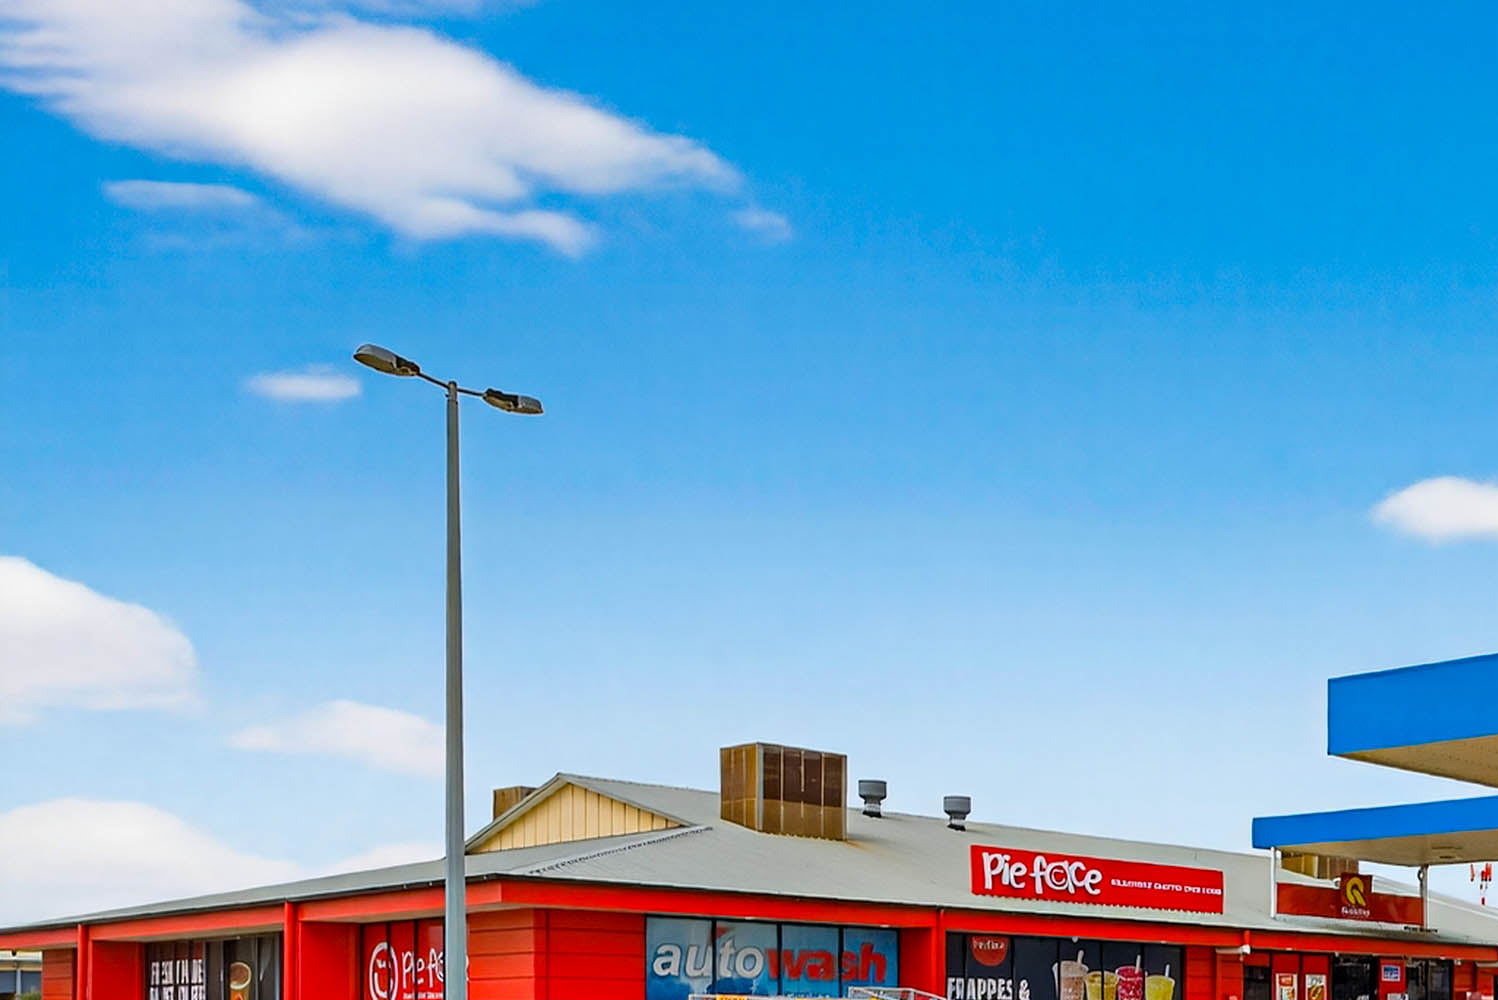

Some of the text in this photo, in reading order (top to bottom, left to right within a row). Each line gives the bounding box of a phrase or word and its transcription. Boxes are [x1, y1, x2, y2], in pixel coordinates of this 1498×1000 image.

[982, 852, 1028, 890] Pie
[1029, 855, 1103, 895] face
[652, 938, 887, 983] autowash
[947, 977, 1013, 1000] FRAPPES
